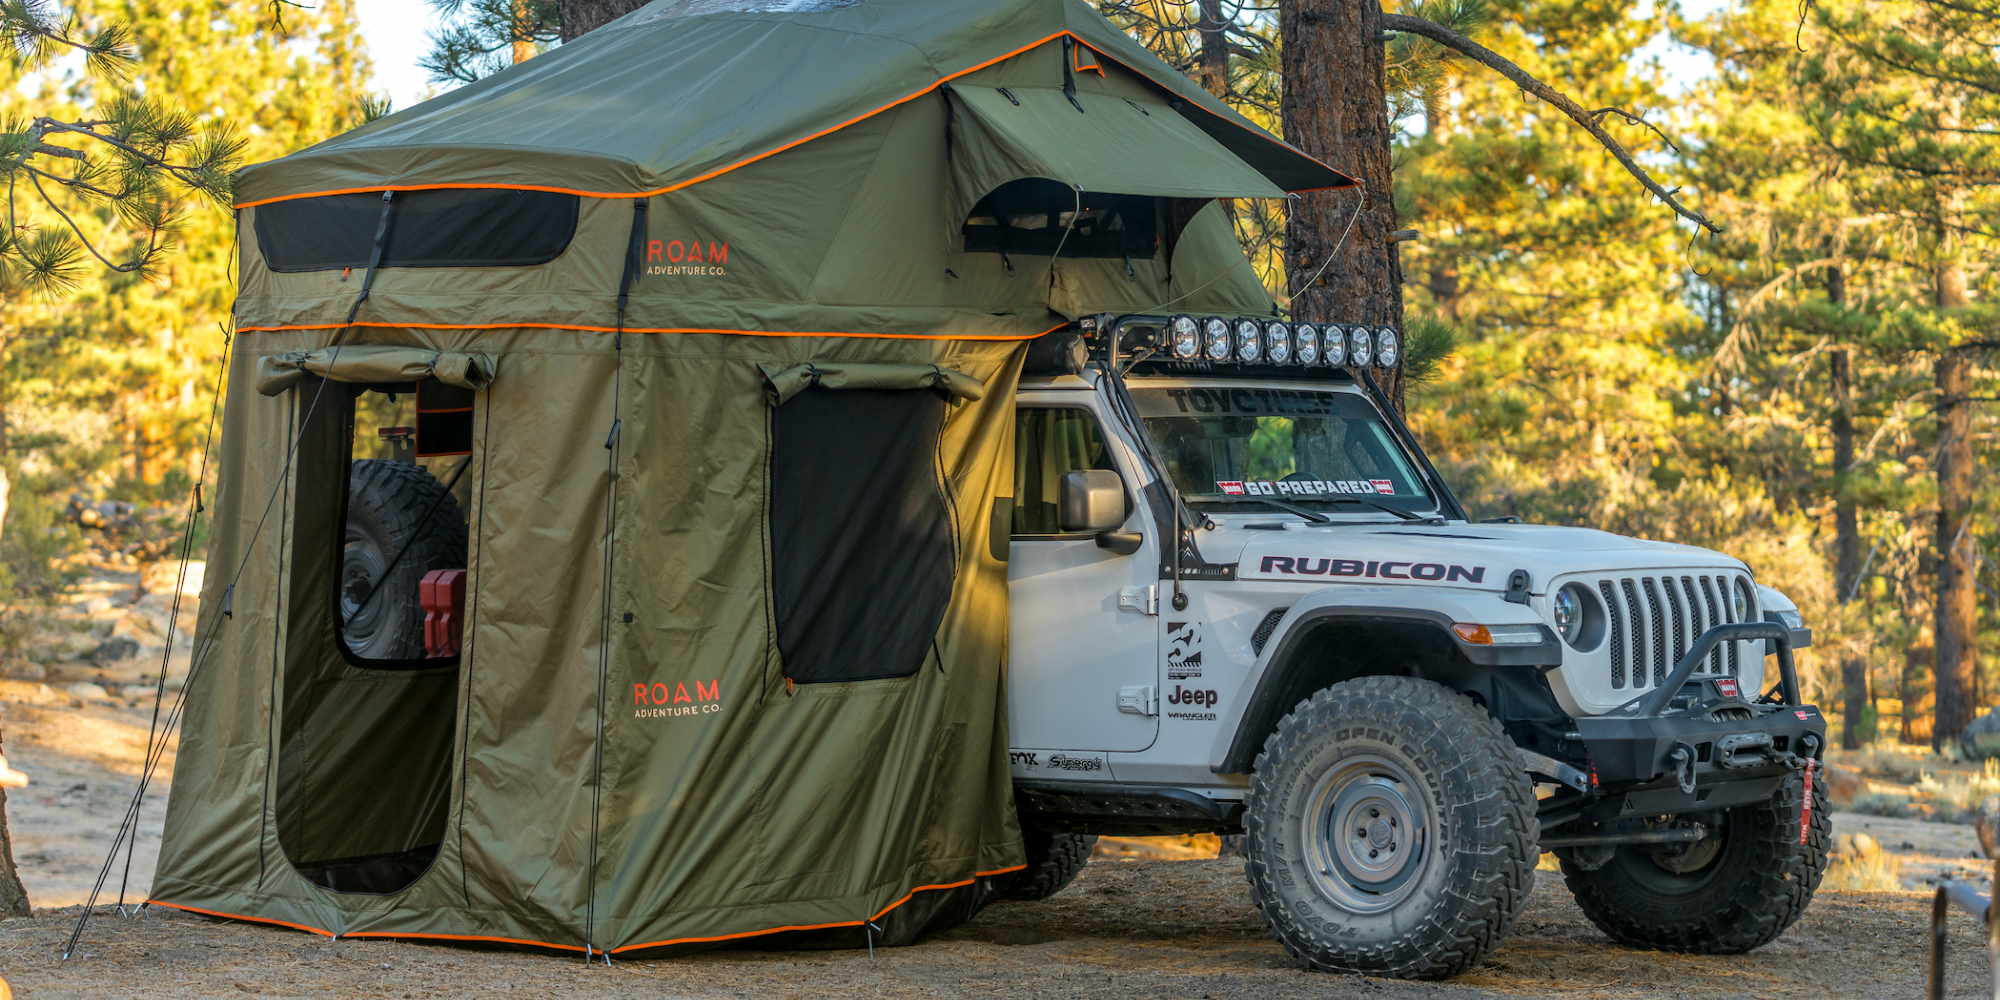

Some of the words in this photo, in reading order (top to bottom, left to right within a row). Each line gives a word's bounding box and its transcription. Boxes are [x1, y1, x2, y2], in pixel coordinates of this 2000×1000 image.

[647, 239, 729, 264] ROAM
[647, 265, 706, 275] ADVENTURE
[709, 266, 726, 275] CO.
[1244, 481, 1275, 495] GO
[1260, 556, 1486, 583] RUBICON
[634, 679, 720, 705] ROAM
[1168, 685, 1218, 709] Jeep
[634, 706, 699, 718] ADVENTURE
[702, 703, 723, 713] CO.
[1009, 752, 1038, 766] FOX
[1335, 727, 1396, 746] OPEN
[1400, 743, 1449, 861] COUNTRY
[1803, 789, 1811, 810] WARN
[1295, 900, 1357, 938] TOYO
